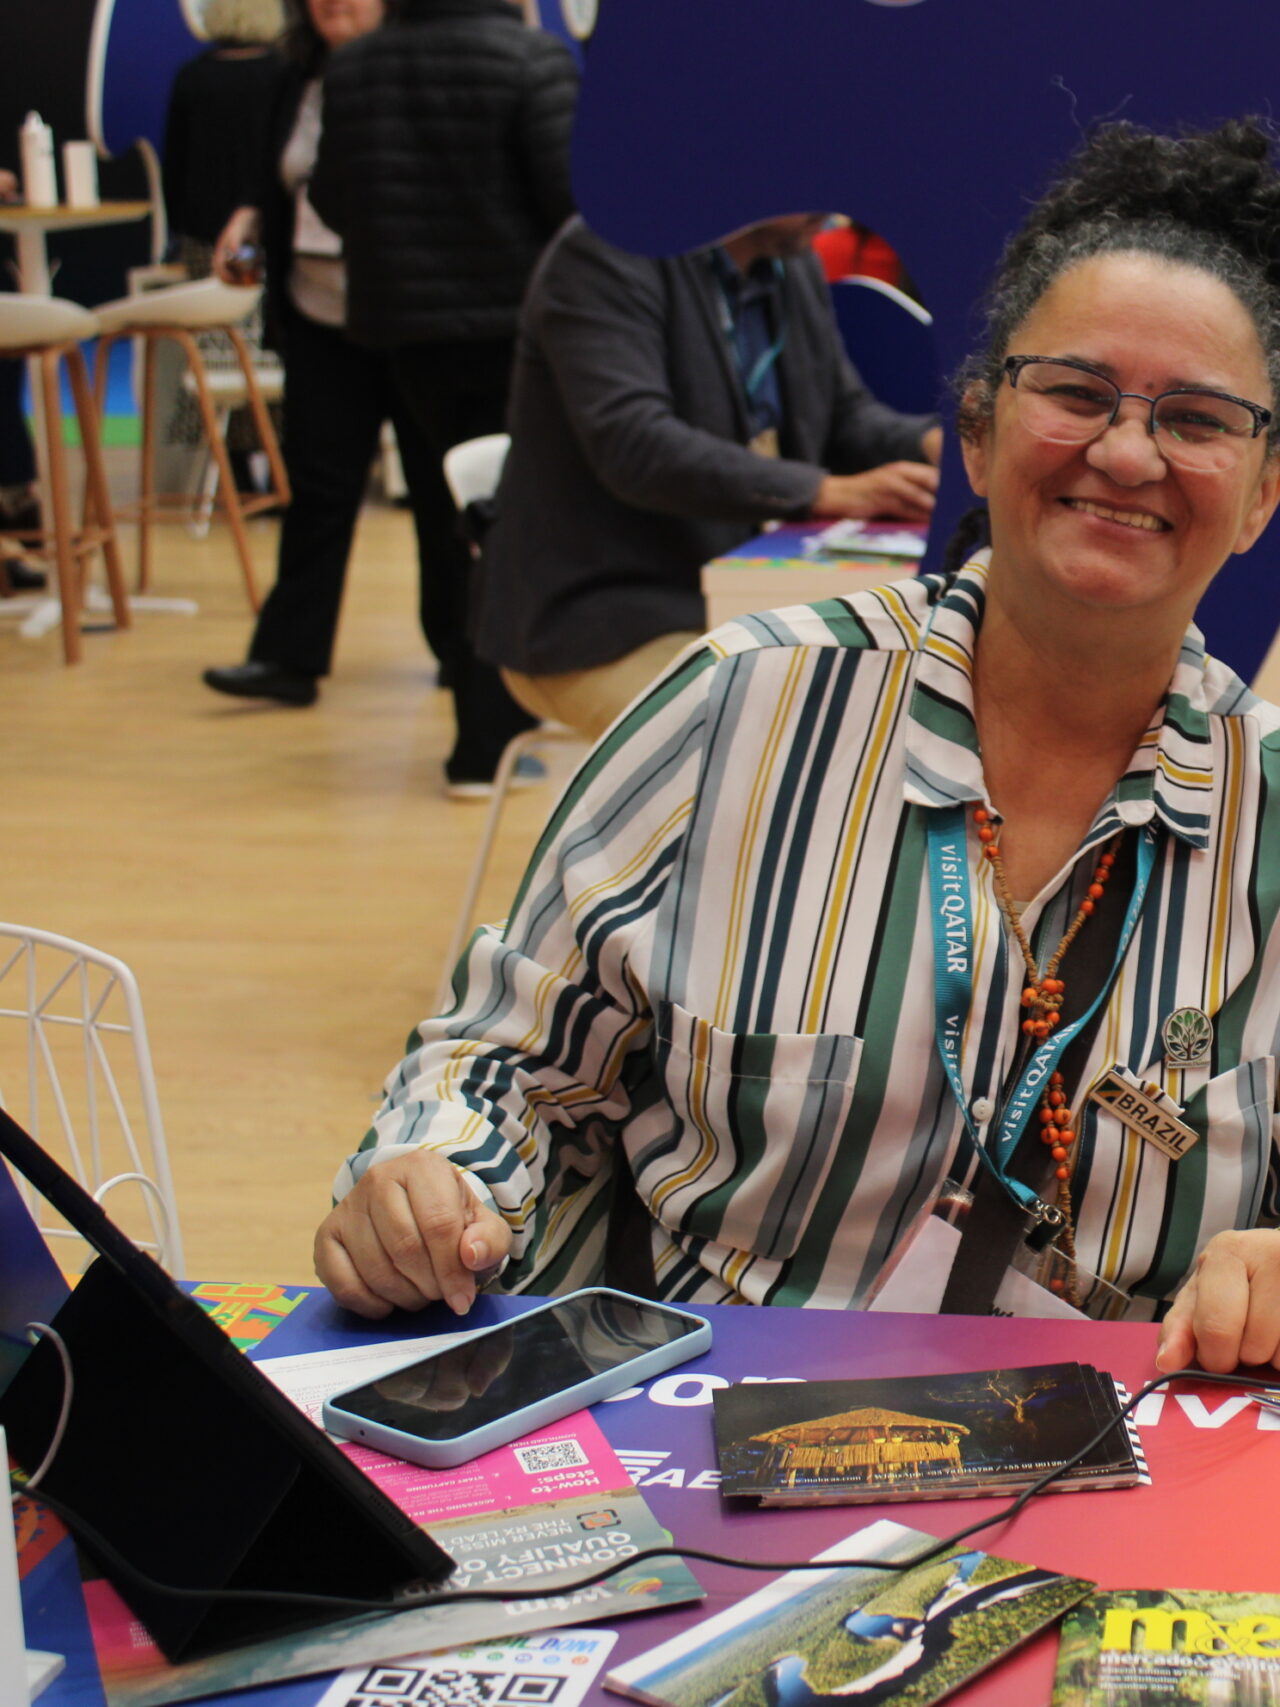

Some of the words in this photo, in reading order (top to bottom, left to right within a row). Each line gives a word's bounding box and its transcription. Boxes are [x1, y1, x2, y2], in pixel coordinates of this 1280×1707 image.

[940, 844, 968, 973] visitQATAR
[1116, 1094, 1188, 1154] BRAZIL
[458, 1474, 485, 1484] START
[536, 1467, 596, 1484] steps:
[405, 1479, 456, 1493] CAPTURING
[530, 1475, 601, 1496] How-to
[445, 1498, 496, 1512] ACCESSING
[501, 1522, 527, 1536] RX
[528, 1517, 569, 1532] THE
[449, 1528, 498, 1545] LEAD
[511, 1525, 573, 1544] NEVER
[458, 1536, 506, 1552] MISS
[496, 1530, 633, 1569] QUALIFY
[483, 1543, 639, 1585] CONNECT
[504, 1587, 614, 1618] wtm
